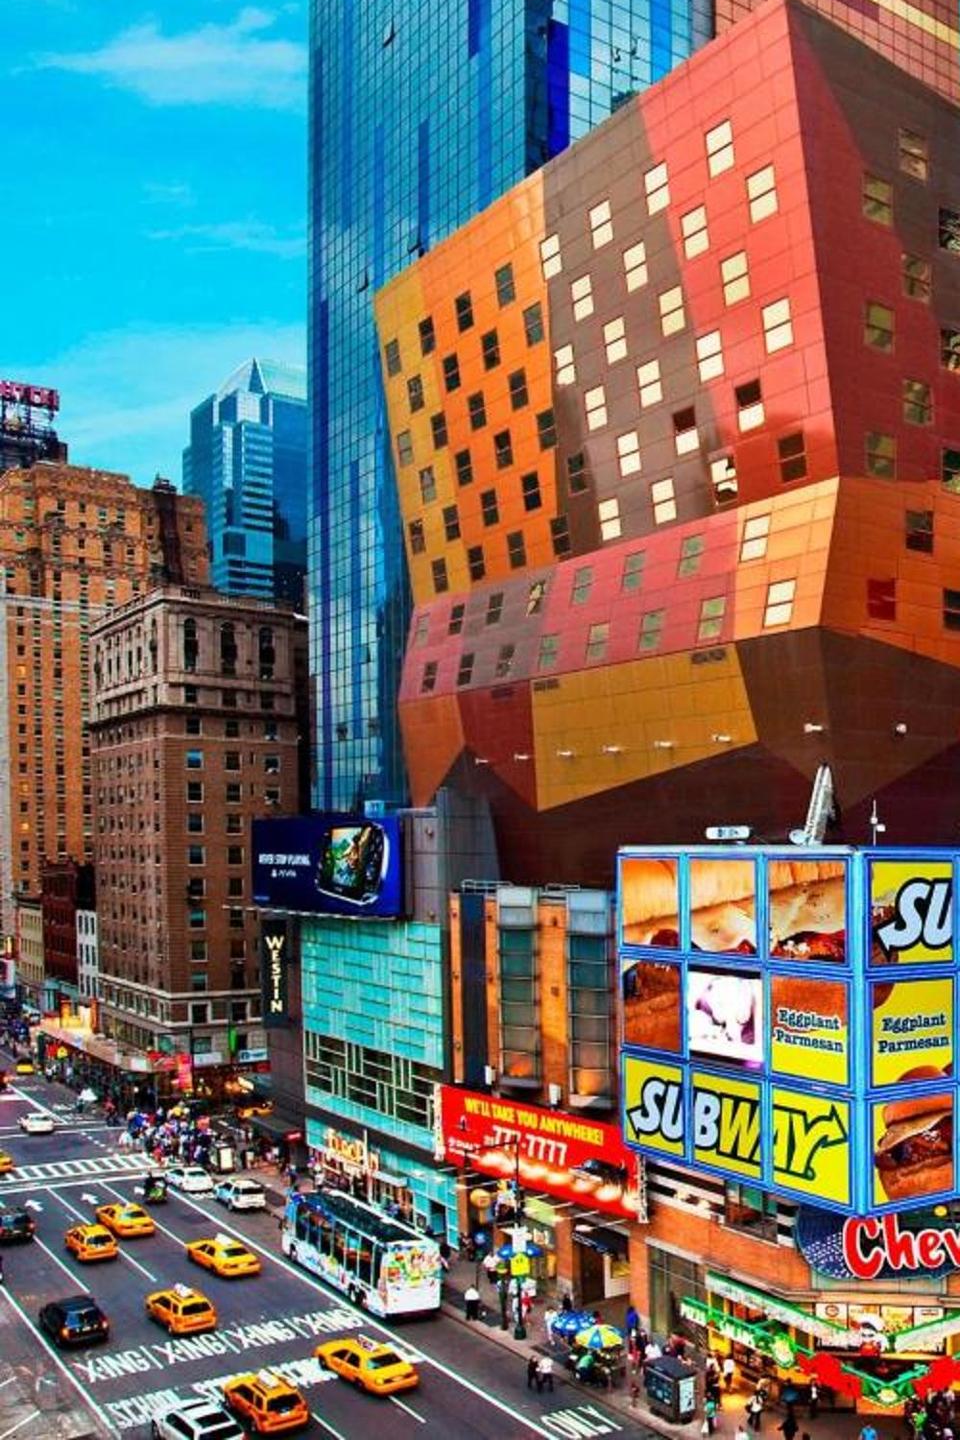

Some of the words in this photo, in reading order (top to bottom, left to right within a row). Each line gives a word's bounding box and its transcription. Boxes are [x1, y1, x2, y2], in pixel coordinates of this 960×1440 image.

[264, 935, 285, 1013] WESTIN
[778, 1009, 841, 1030] Eggplant
[882, 1013, 946, 1034] Eggplant
[776, 1029, 843, 1053] Parmesan
[877, 1035, 950, 1054] Parmesan
[464, 1096, 491, 1117] WE'LL
[491, 1103, 516, 1124] TAKE
[517, 1109, 538, 1129] YOU
[540, 1115, 605, 1147] ANYWHERE!
[626, 1076, 848, 1180] SUBWAY
[541, 1405, 623, 1439] ONLY
